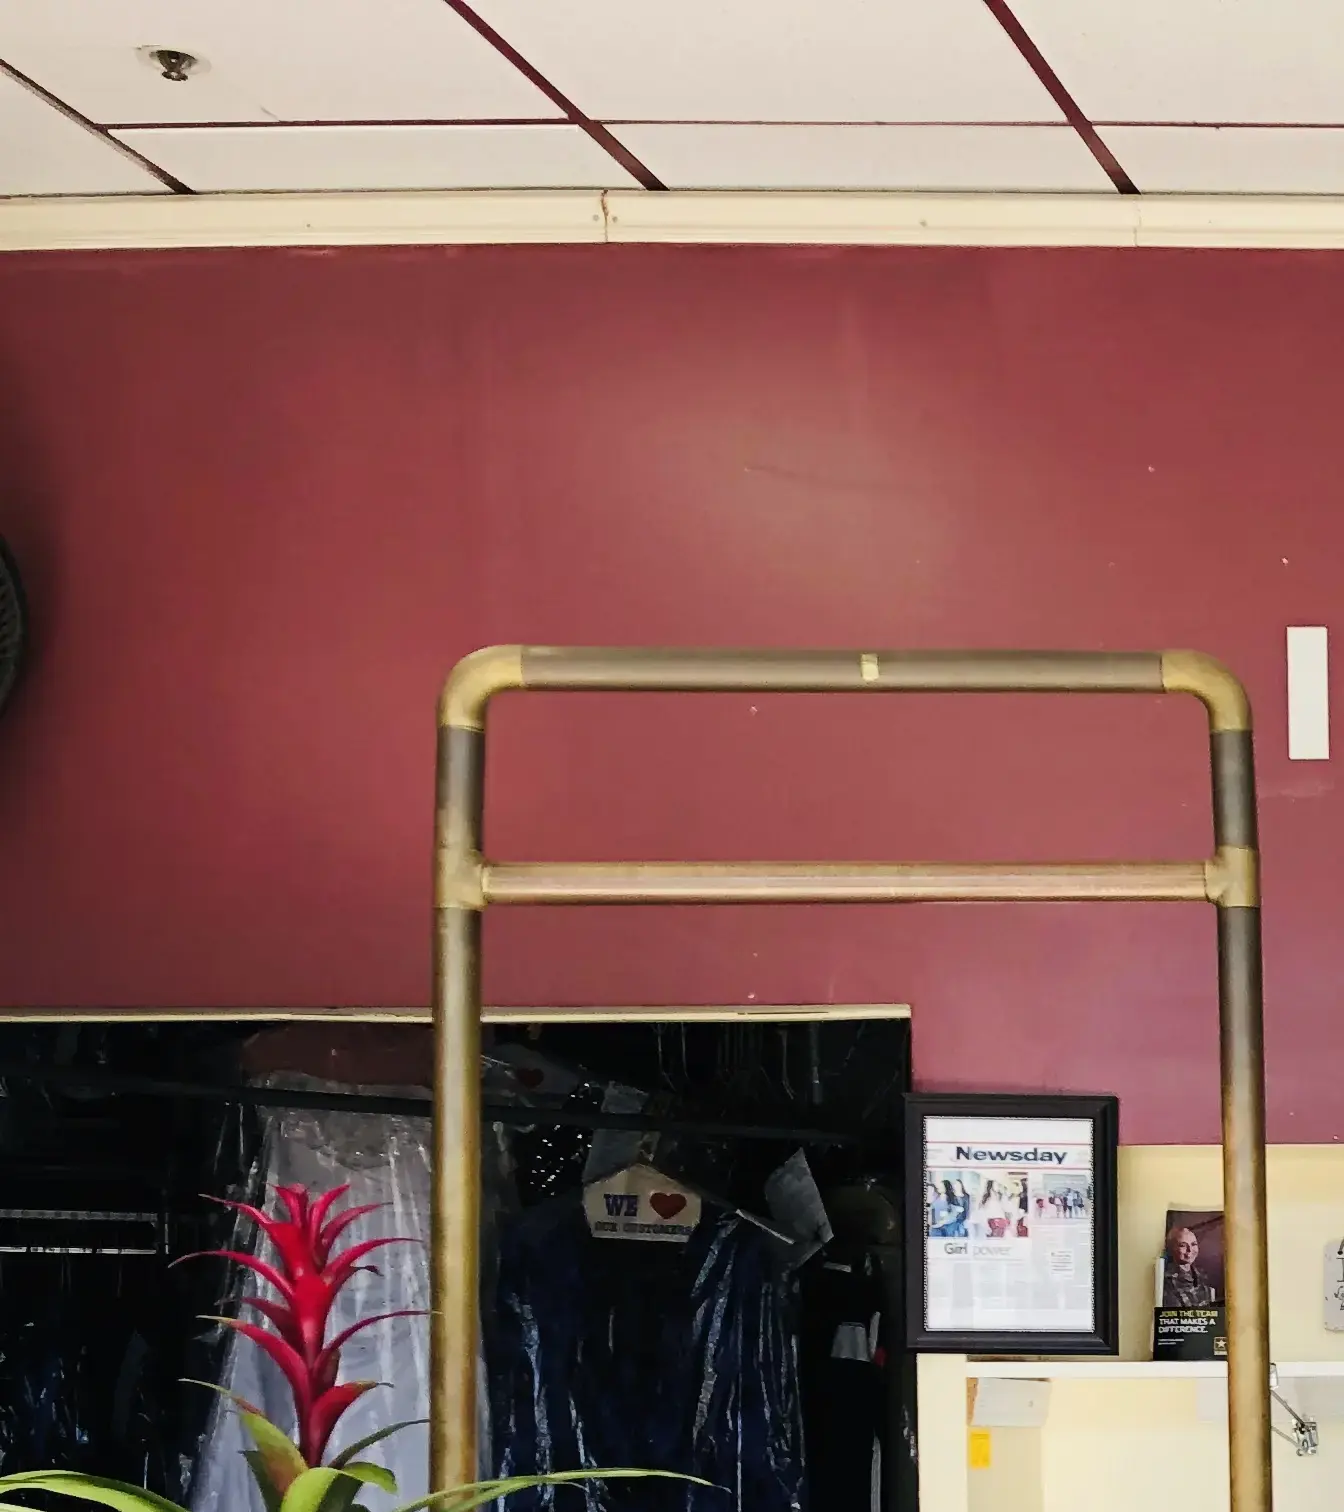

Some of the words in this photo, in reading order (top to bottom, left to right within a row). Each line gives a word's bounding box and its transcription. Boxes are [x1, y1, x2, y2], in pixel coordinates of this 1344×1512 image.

[956, 1146, 1067, 1165] Newsday
[604, 1193, 638, 1216] WE
[1180, 1317, 1208, 1325] MAKES
[1158, 1325, 1209, 1333] DIFFERENCE.
